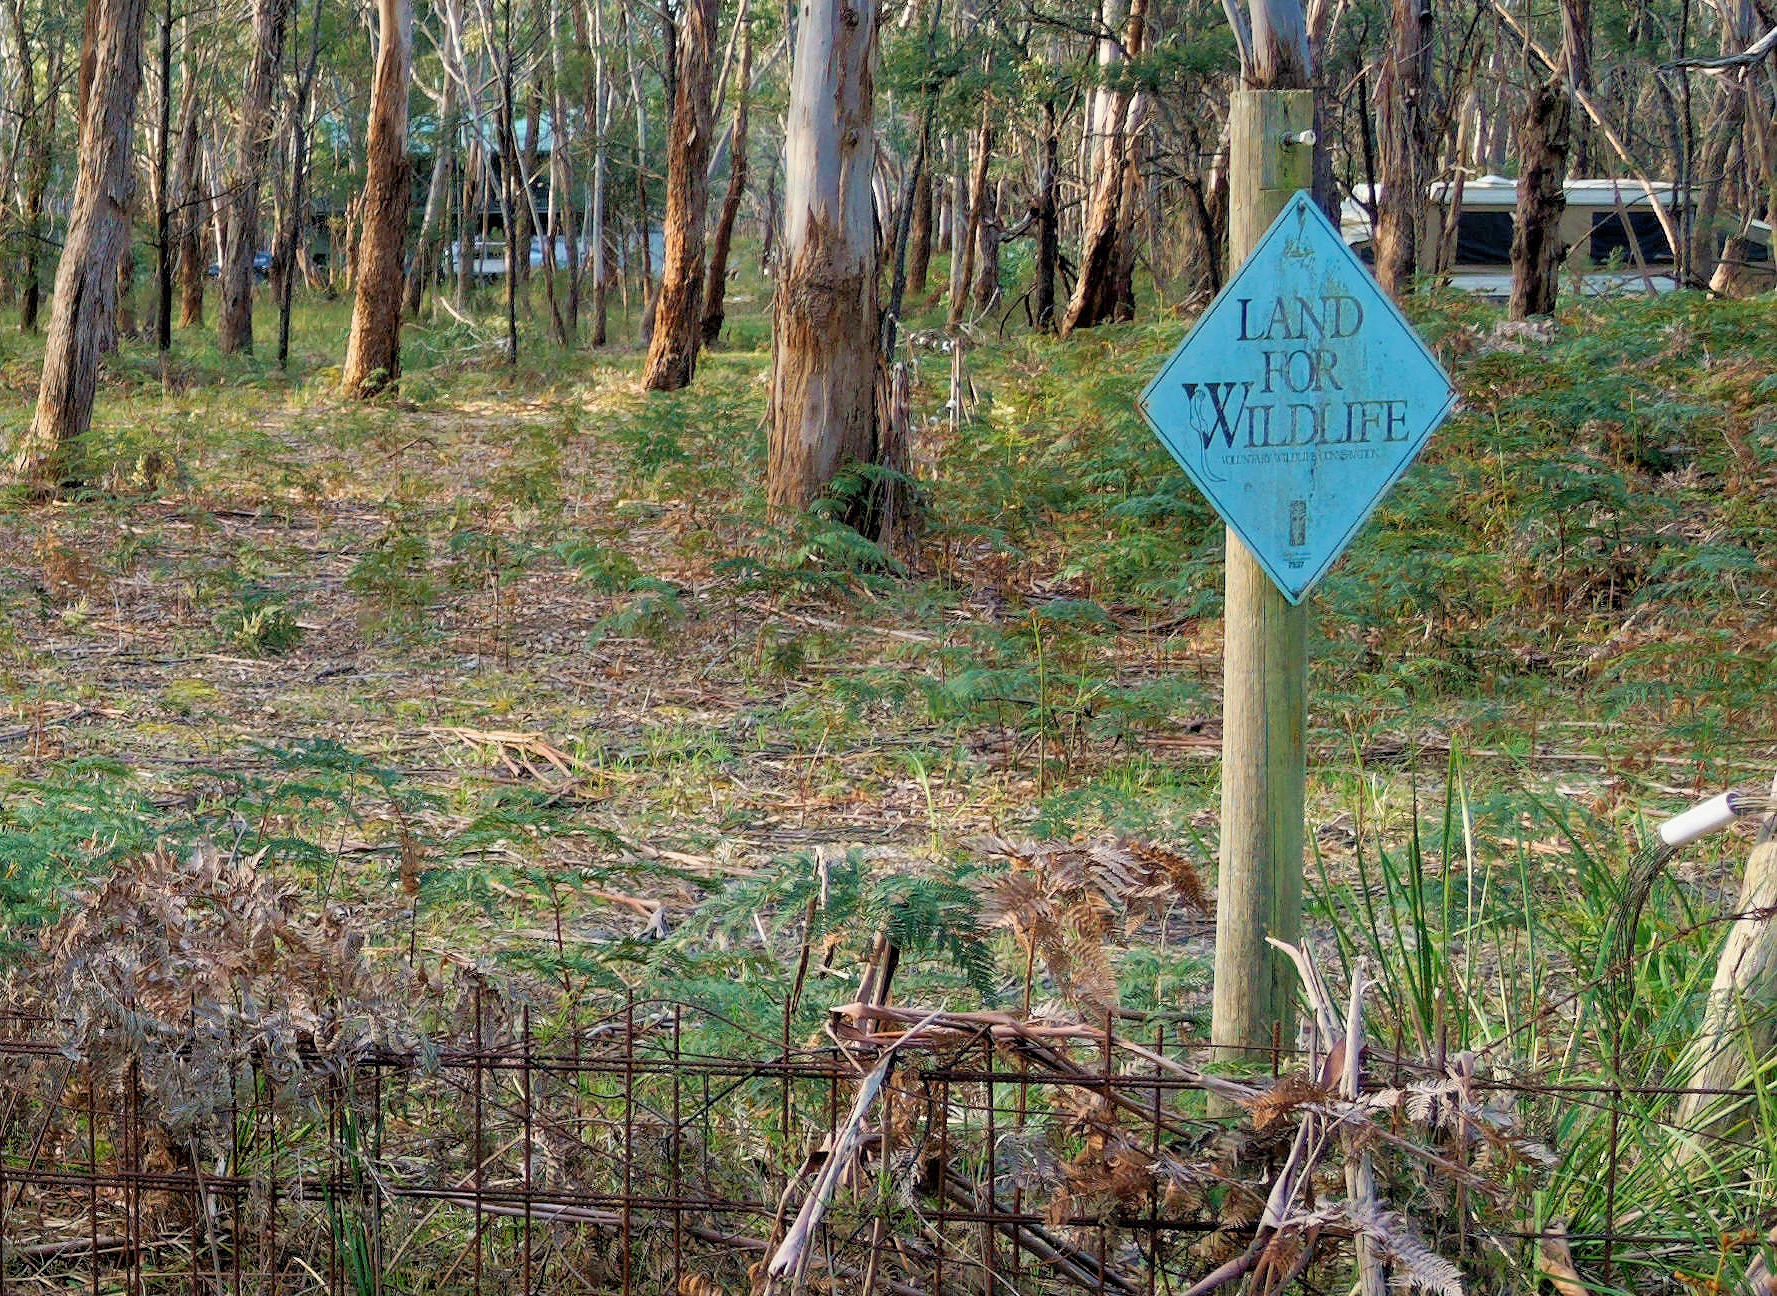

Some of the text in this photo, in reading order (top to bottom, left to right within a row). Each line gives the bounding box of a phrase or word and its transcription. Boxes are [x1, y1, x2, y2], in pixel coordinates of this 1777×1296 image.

[1236, 296, 1364, 342] LAND
[1260, 349, 1344, 394] FOR
[1181, 381, 1410, 450] WILDLIFE
